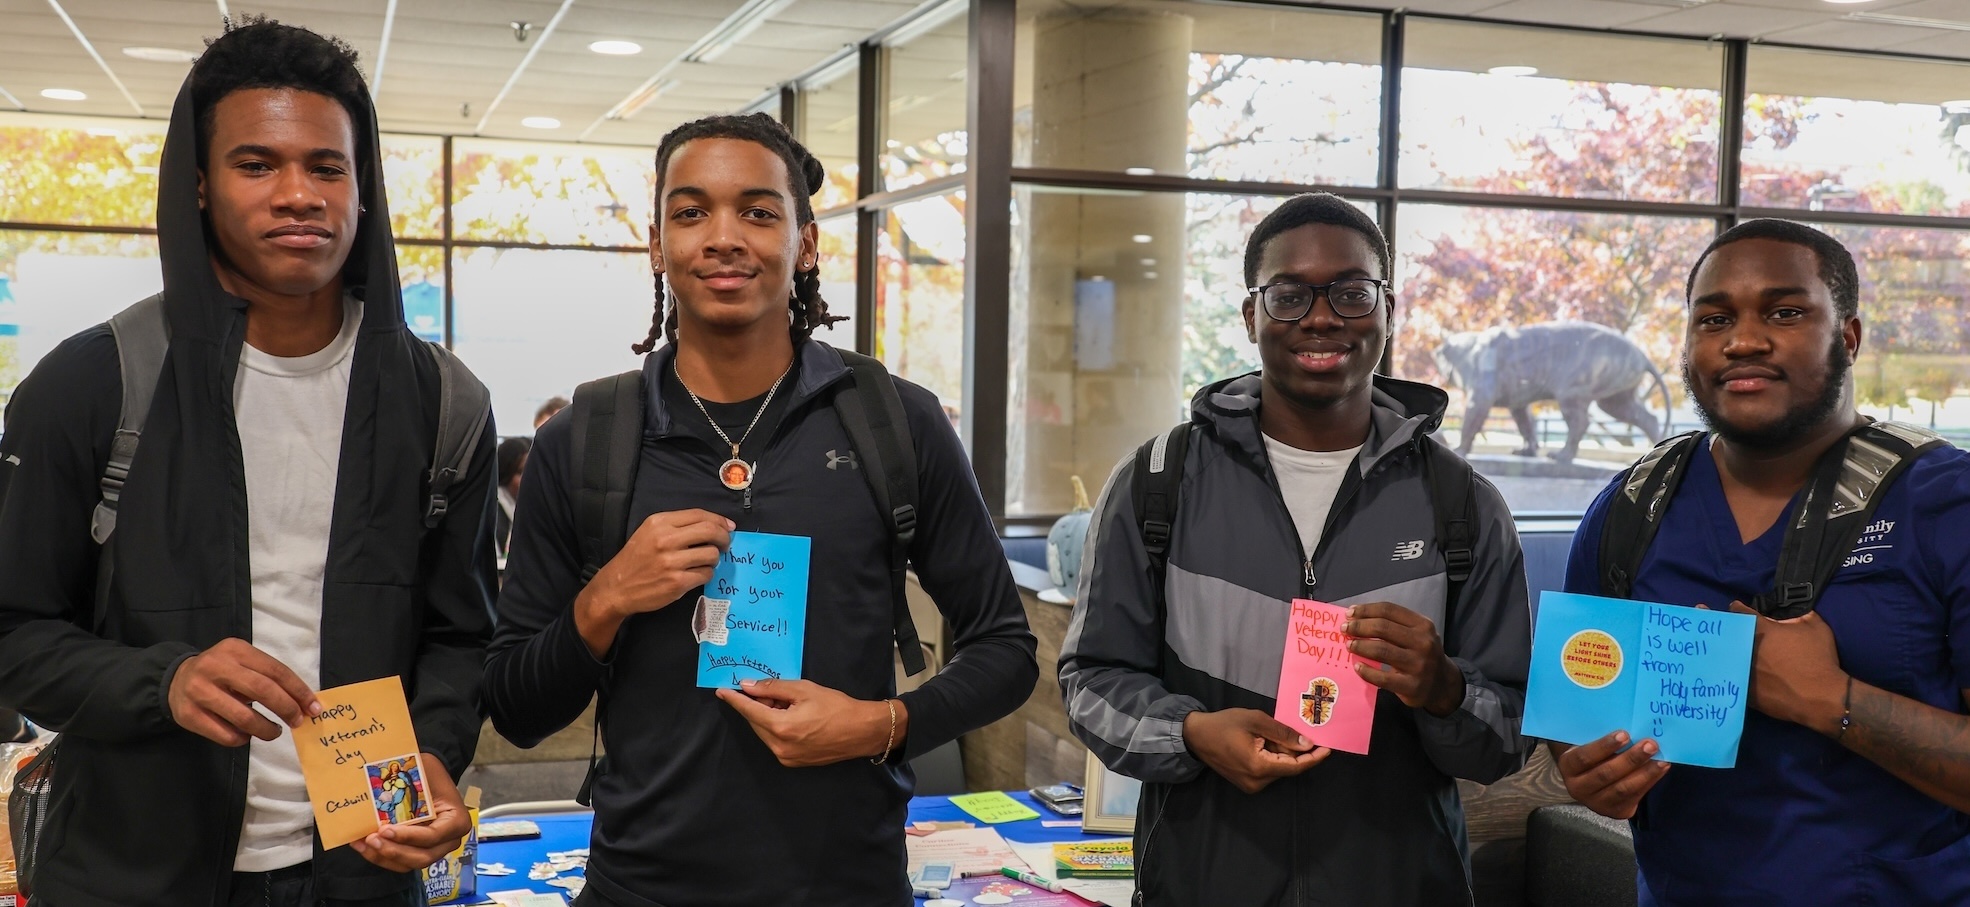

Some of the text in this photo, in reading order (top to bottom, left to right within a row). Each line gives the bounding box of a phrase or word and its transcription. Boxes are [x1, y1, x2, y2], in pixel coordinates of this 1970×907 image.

[718, 578, 785, 604] for your
[1292, 601, 1339, 627] Happy
[1649, 606, 1722, 636] Hope all
[726, 613, 788, 637] Service!!
[1592, 643, 1610, 651] YOUR
[1646, 627, 1707, 656] is well
[706, 652, 738, 667] Happy
[1574, 648, 1592, 656] LIGHT
[1592, 659, 1617, 668] OTHERS
[1641, 651, 1684, 675] from
[335, 749, 367, 770] day
[428, 860, 447, 878] 64
[425, 880, 455, 893] ASHABLE
[427, 889, 451, 900] RAYONS
